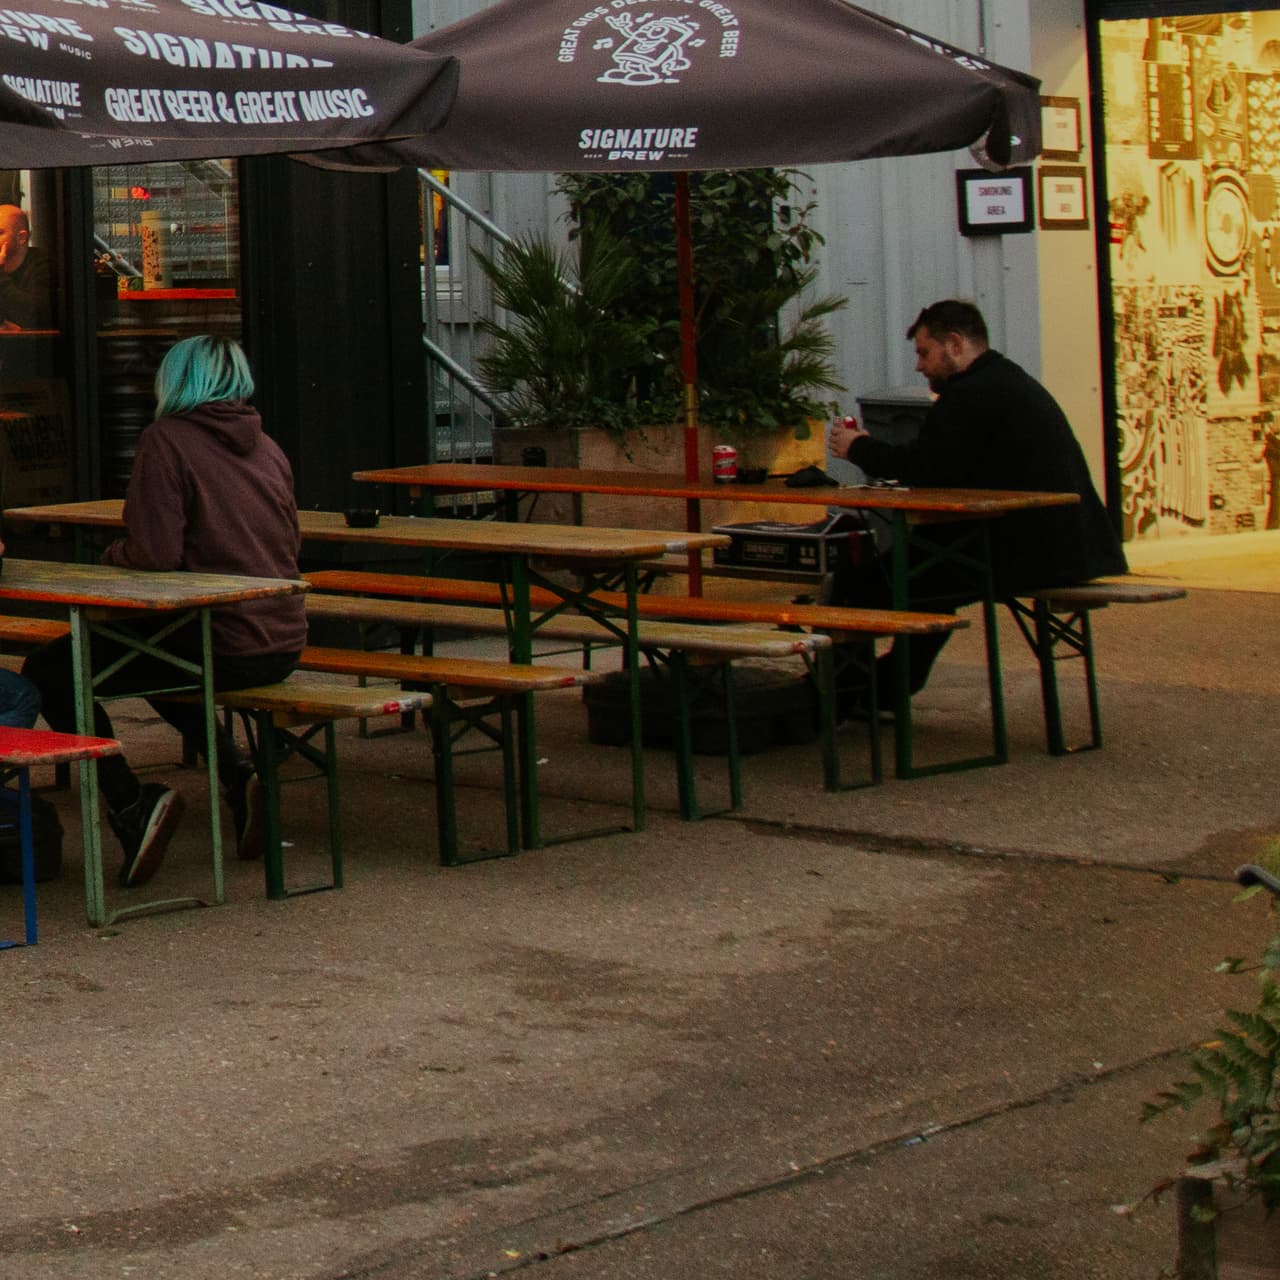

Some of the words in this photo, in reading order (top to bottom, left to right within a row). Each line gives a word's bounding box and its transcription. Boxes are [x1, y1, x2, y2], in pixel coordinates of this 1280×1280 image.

[558, 28, 582, 63] GREAT
[572, 6, 609, 28] GIGS
[699, 0, 739, 28] GREAT
[719, 30, 740, 58] BEER
[59, 43, 93, 61] MUSIC
[1, 74, 82, 107] SIGNATURE
[104, 87, 167, 122] GREAT
[163, 89, 221, 122] BEER
[216, 90, 238, 124] &
[234, 90, 299, 124] GREAT
[298, 87, 375, 122] MUSIC
[578, 127, 699, 150] SIGNATURE
[607, 150, 665, 161] BREW
